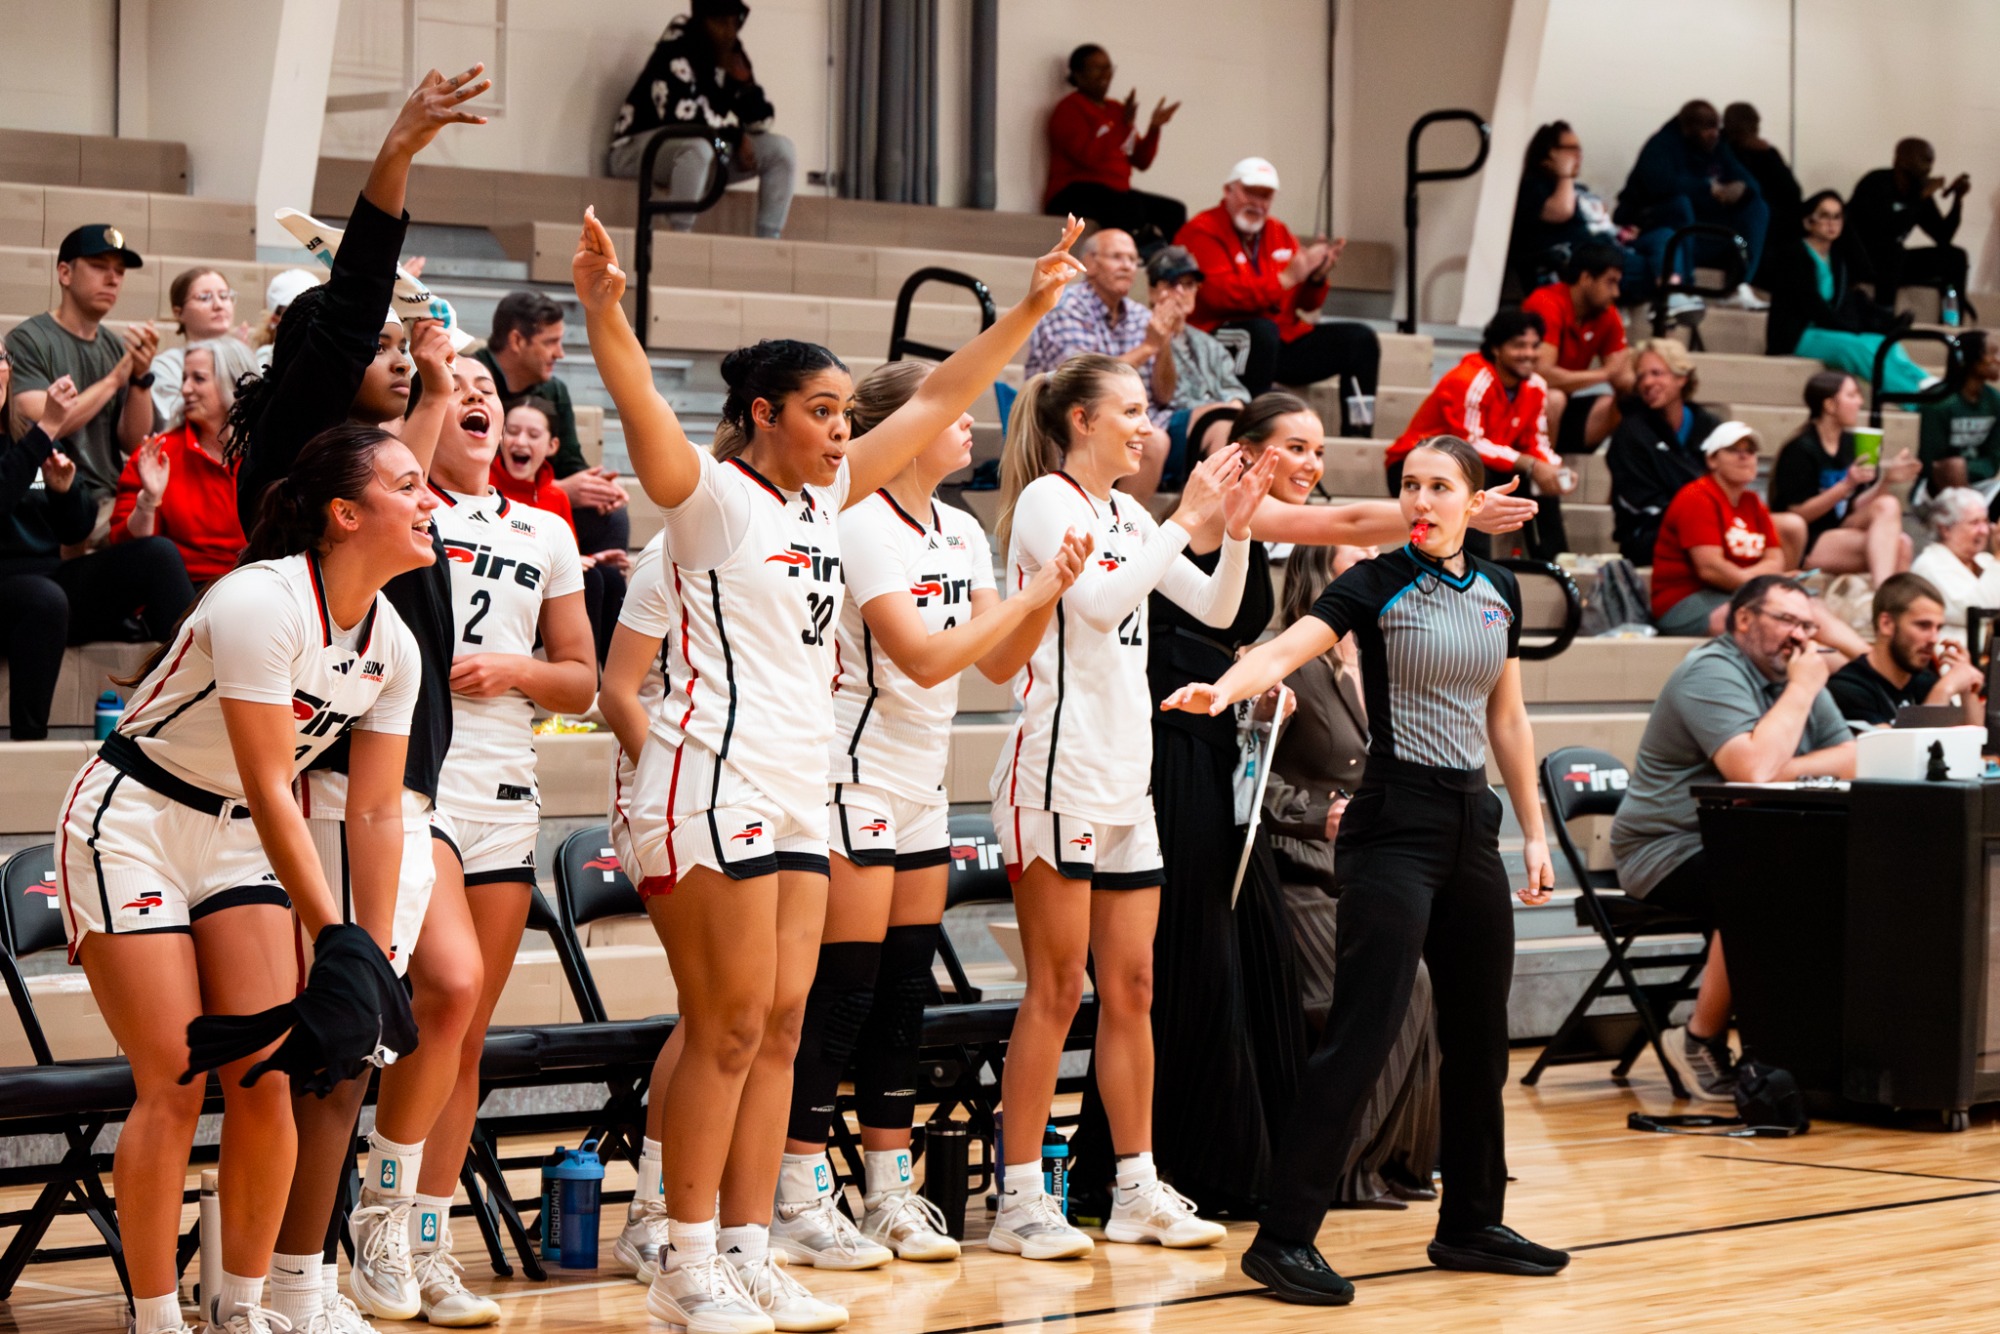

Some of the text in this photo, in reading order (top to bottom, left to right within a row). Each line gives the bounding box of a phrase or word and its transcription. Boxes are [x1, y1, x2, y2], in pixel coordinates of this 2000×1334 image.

[510, 520, 531, 533] SUN
[909, 573, 972, 608] Fir
[462, 589, 491, 645] 2
[801, 592, 834, 646] 30
[363, 660, 384, 676] SUN
[1563, 763, 1630, 792] Fire
[950, 836, 1003, 871] Fir
